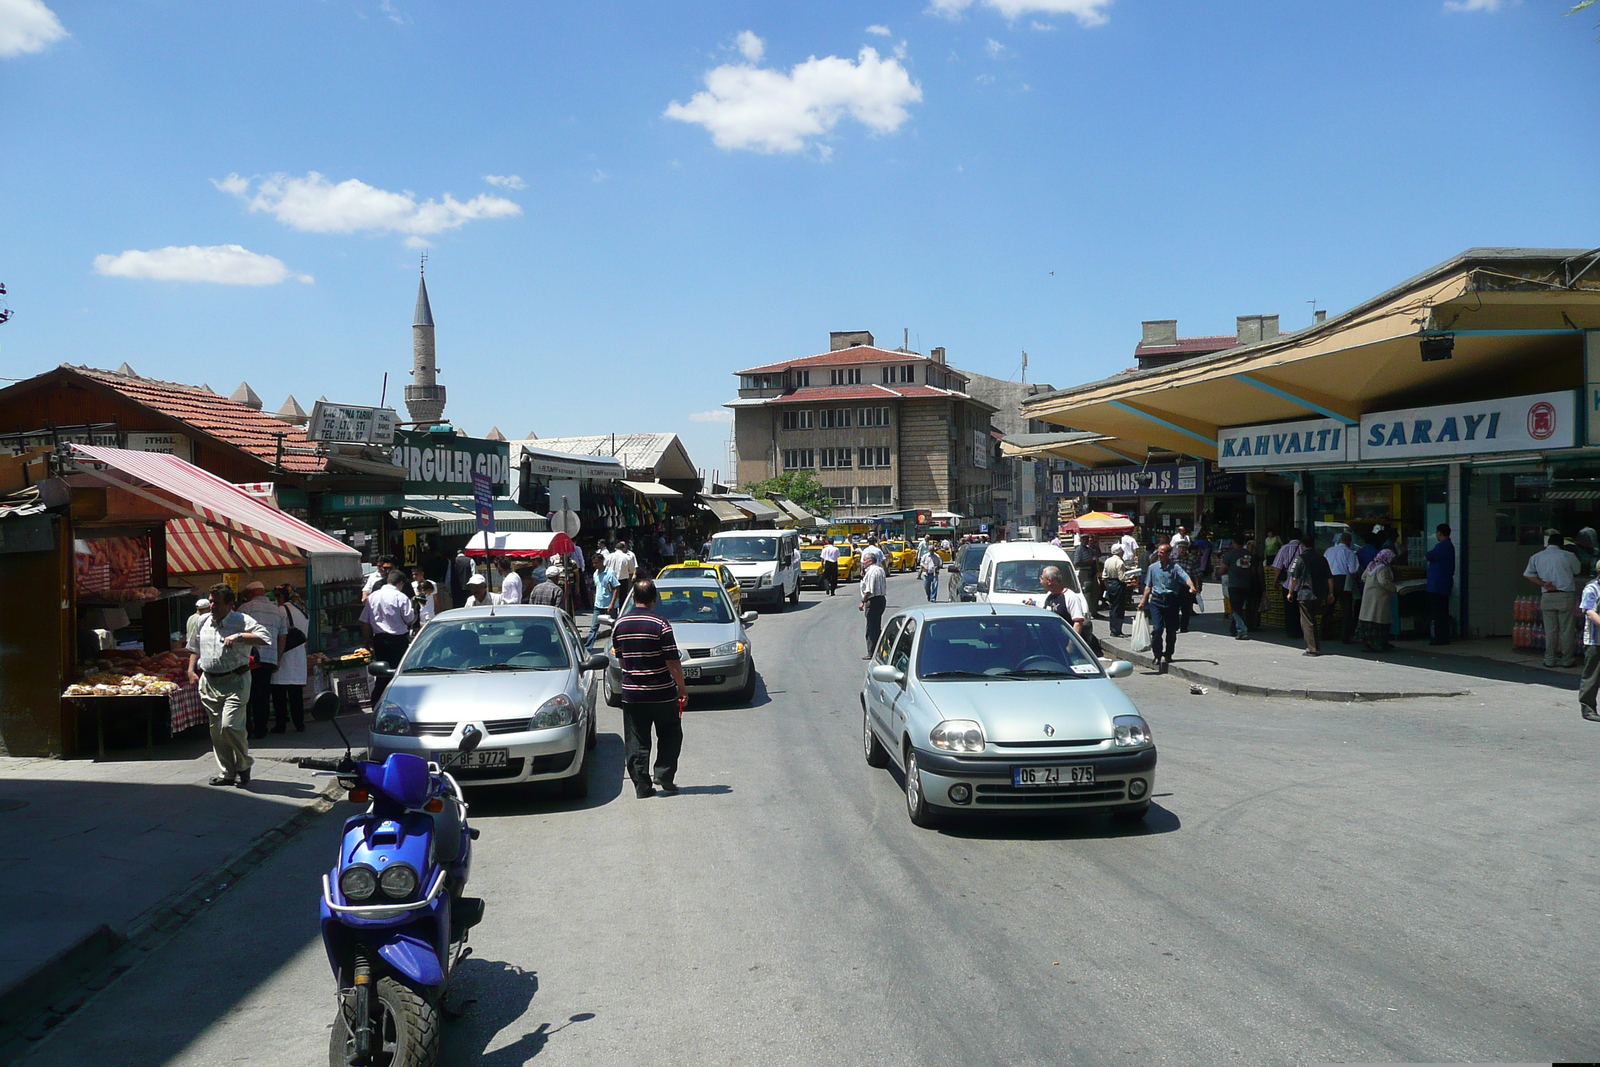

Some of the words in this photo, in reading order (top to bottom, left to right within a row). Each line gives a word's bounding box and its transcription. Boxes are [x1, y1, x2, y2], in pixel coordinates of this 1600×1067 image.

[1222, 428, 1341, 458] KAHVALTI
[1367, 412, 1501, 447] SARAYI
[391, 437, 473, 482] BİRGÜLER
[475, 452, 511, 484] GIDA
[460, 752, 473, 765] BF
[478, 751, 506, 764] 9772
[1021, 768, 1036, 783] 06
[1045, 768, 1060, 782] ZJ
[1071, 766, 1093, 781] 675
